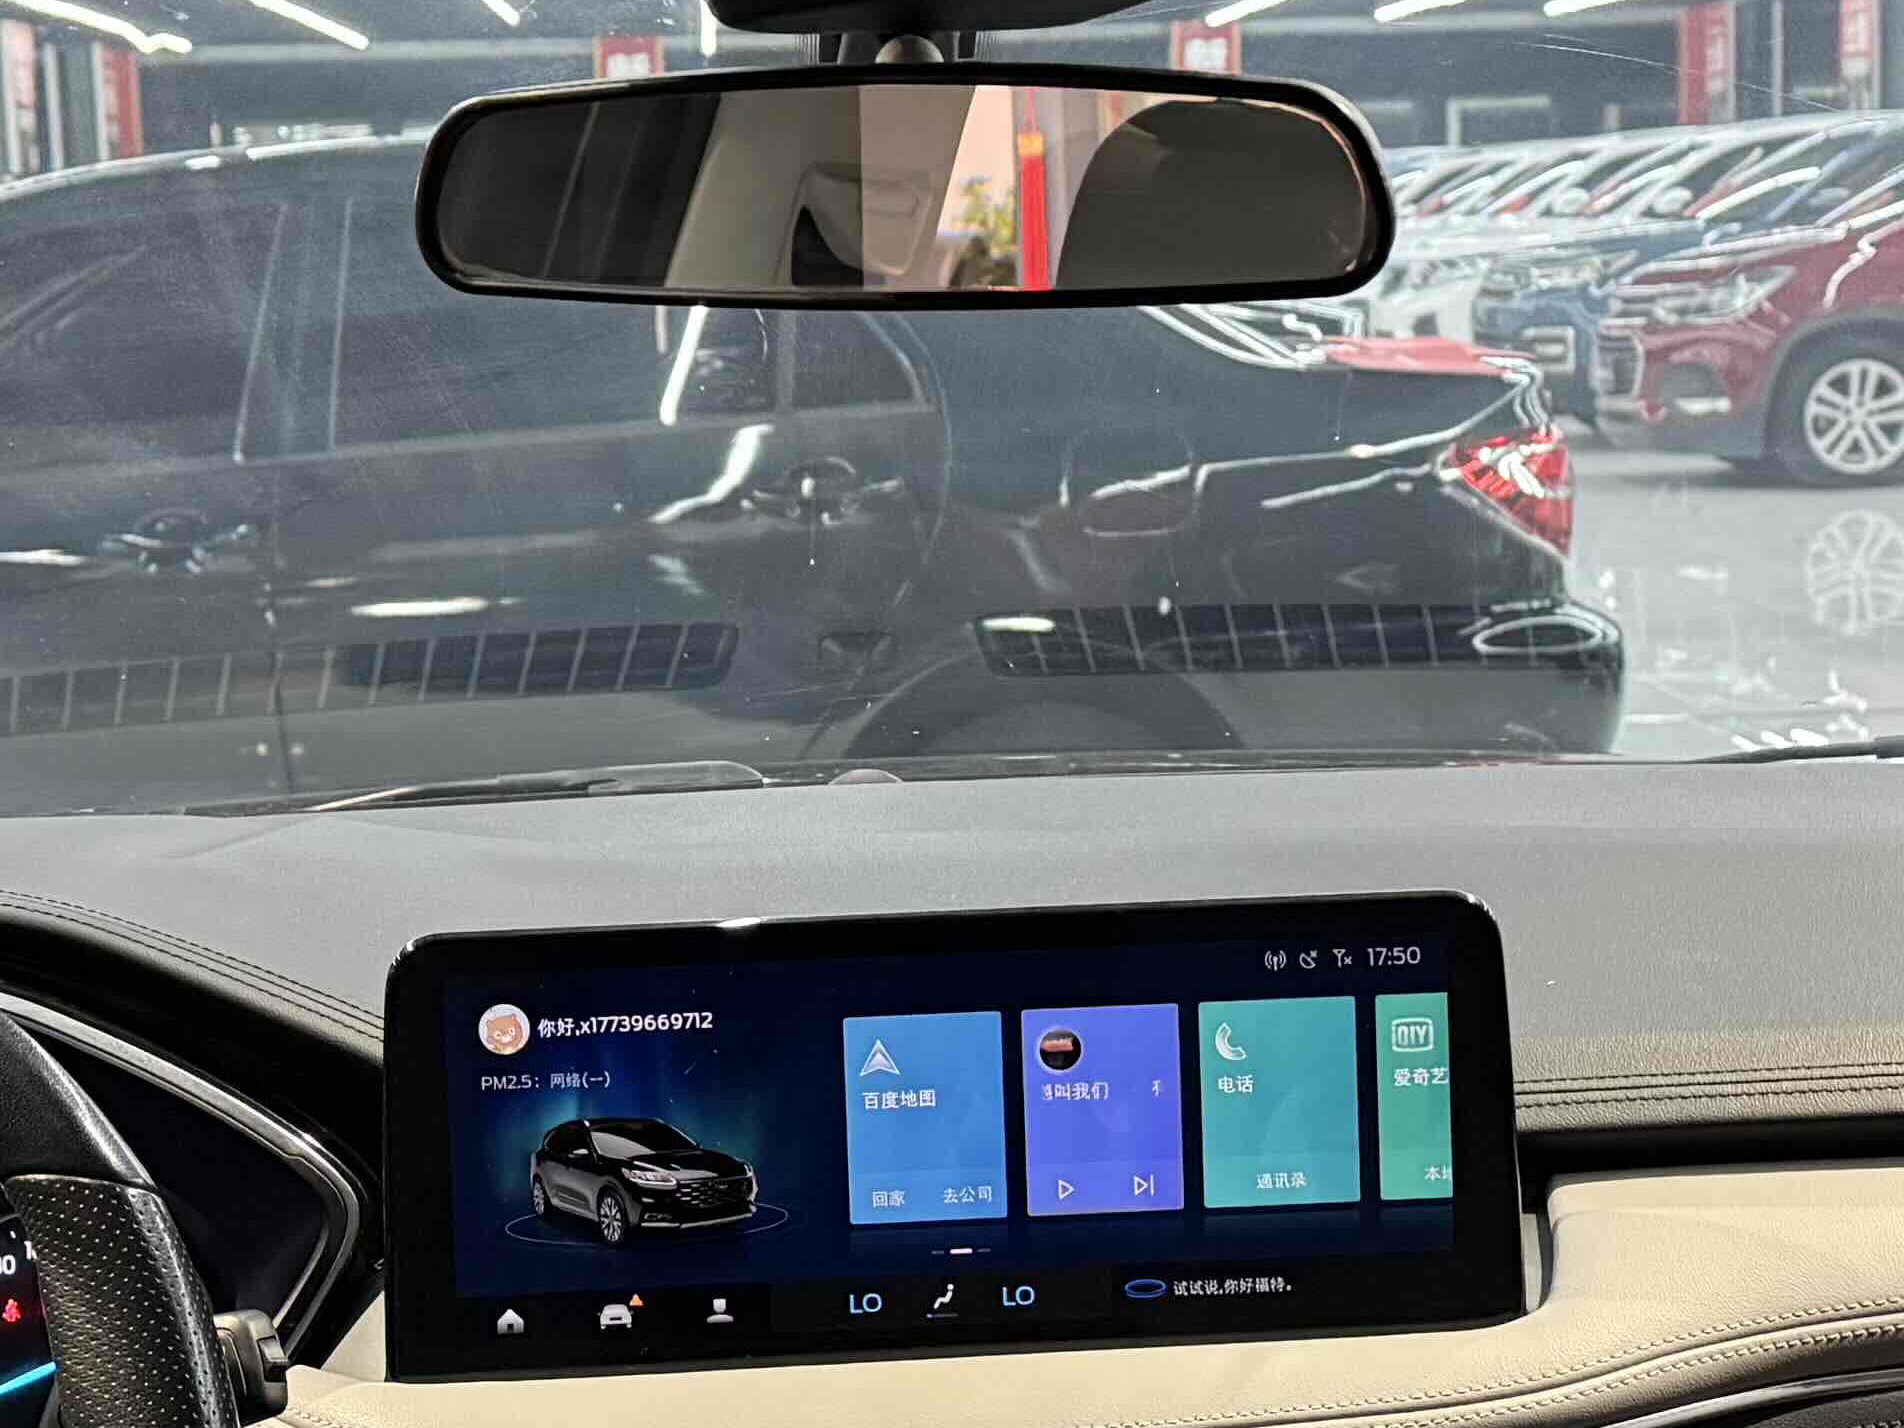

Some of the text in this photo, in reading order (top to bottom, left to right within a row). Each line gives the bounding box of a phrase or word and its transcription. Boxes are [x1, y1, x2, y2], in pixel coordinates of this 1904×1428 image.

[1367, 946, 1421, 966] 17:50
[1217, 1074, 1254, 1093] 电话
[1393, 1067, 1449, 1086] 爱奇艺
[862, 1088, 937, 1110] 百度地图
[872, 1185, 993, 1208] 回家 去公司
[849, 1293, 883, 1314] LO
[1002, 1285, 1035, 1307] LO
